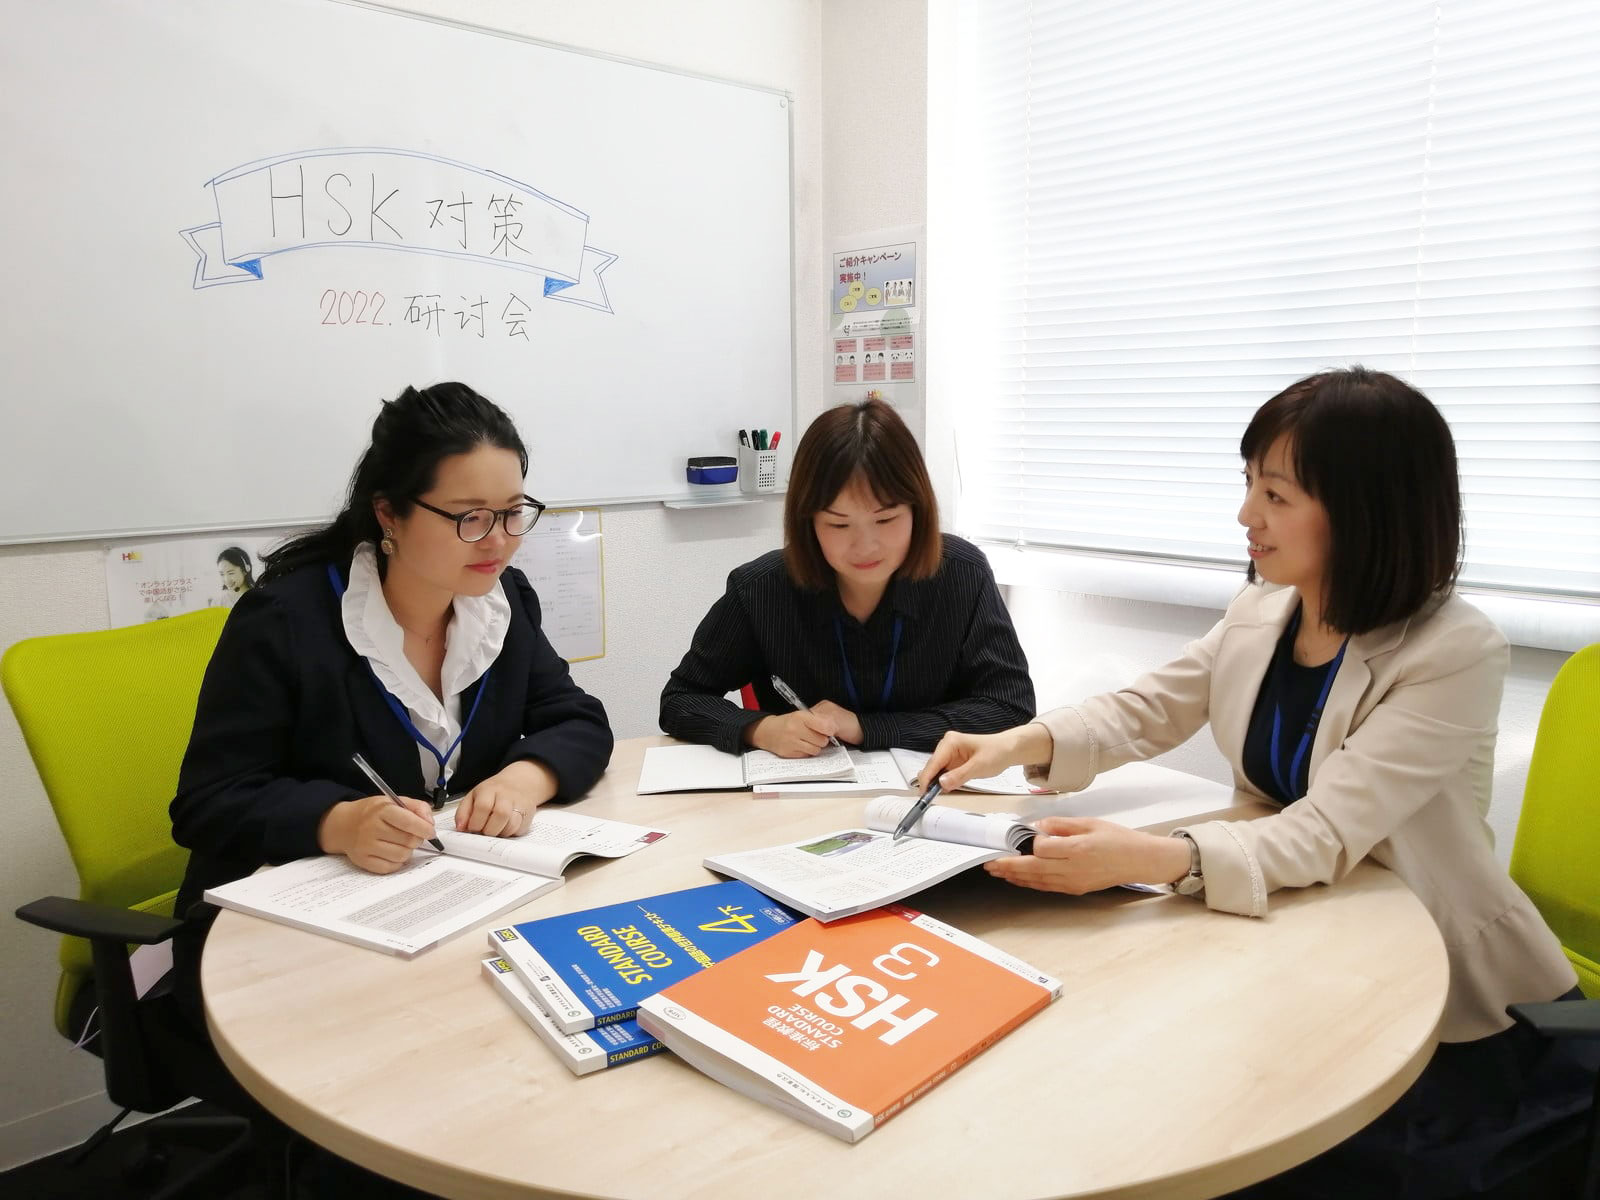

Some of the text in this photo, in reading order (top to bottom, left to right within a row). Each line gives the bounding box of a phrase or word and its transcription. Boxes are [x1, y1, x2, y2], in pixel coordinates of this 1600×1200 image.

[269, 165, 531, 256] HSK 对策
[839, 252, 901, 268] ご紹介キャンペーン
[403, 293, 531, 342] 研讨会
[577, 925, 653, 985] STANDARD
[611, 924, 673, 969] COURSE
[872, 942, 940, 980] 3
[763, 949, 939, 1046] HSK
[788, 1003, 844, 1036] COURSE
[762, 1016, 821, 1051] 标准教程
[767, 1005, 843, 1049] STANDARD
[609, 1045, 649, 1062] STANDARD
